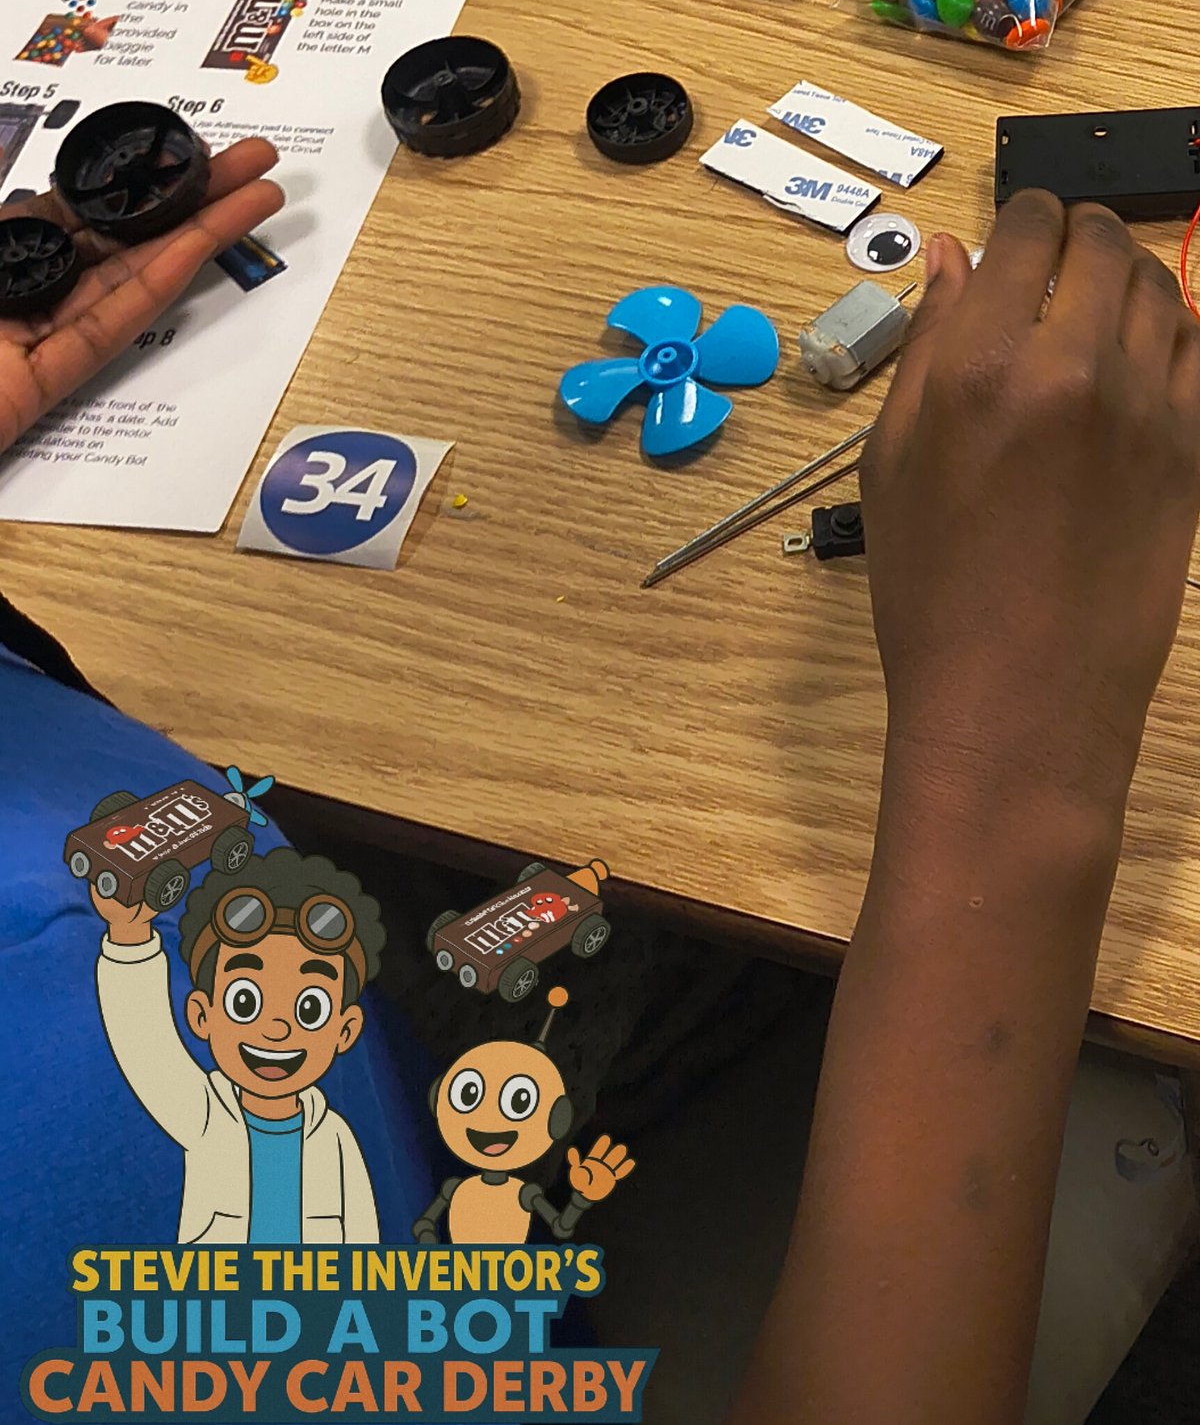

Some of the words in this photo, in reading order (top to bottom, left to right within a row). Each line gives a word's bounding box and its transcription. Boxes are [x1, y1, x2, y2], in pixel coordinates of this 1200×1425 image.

[127, 0, 174, 13] candy
[175, 2, 188, 13] in
[315, 7, 344, 16] hole
[345, 9, 357, 17] in
[359, 9, 381, 18] the
[308, 19, 334, 28] box
[354, 21, 376, 30] the
[302, 30, 325, 39] left
[326, 32, 354, 41] side
[355, 33, 372, 42] of
[297, 42, 318, 51] the
[320, 43, 354, 53] letter
[357, 45, 372, 54] M
[94, 54, 115, 64] for
[117, 56, 152, 66] later
[0, 80, 41, 101] Step
[43, 83, 59, 99] 5
[167, 95, 206, 117] Step
[210, 98, 225, 113] 6
[781, 110, 826, 135] 3M
[784, 176, 834, 201] 3M
[836, 183, 870, 198] 9448A
[160, 329, 176, 346] 8
[108, 399, 137, 411] front
[139, 402, 152, 410] of
[156, 402, 177, 412] the
[150, 416, 180, 427] Add
[77, 426, 91, 435] to
[93, 426, 112, 436] the
[115, 428, 152, 438] motor
[87, 441, 104, 449] on
[53, 453, 82, 463] your
[84, 454, 125, 466] Candy
[125, 455, 147, 466] Bot
[281, 450, 398, 521] 34
